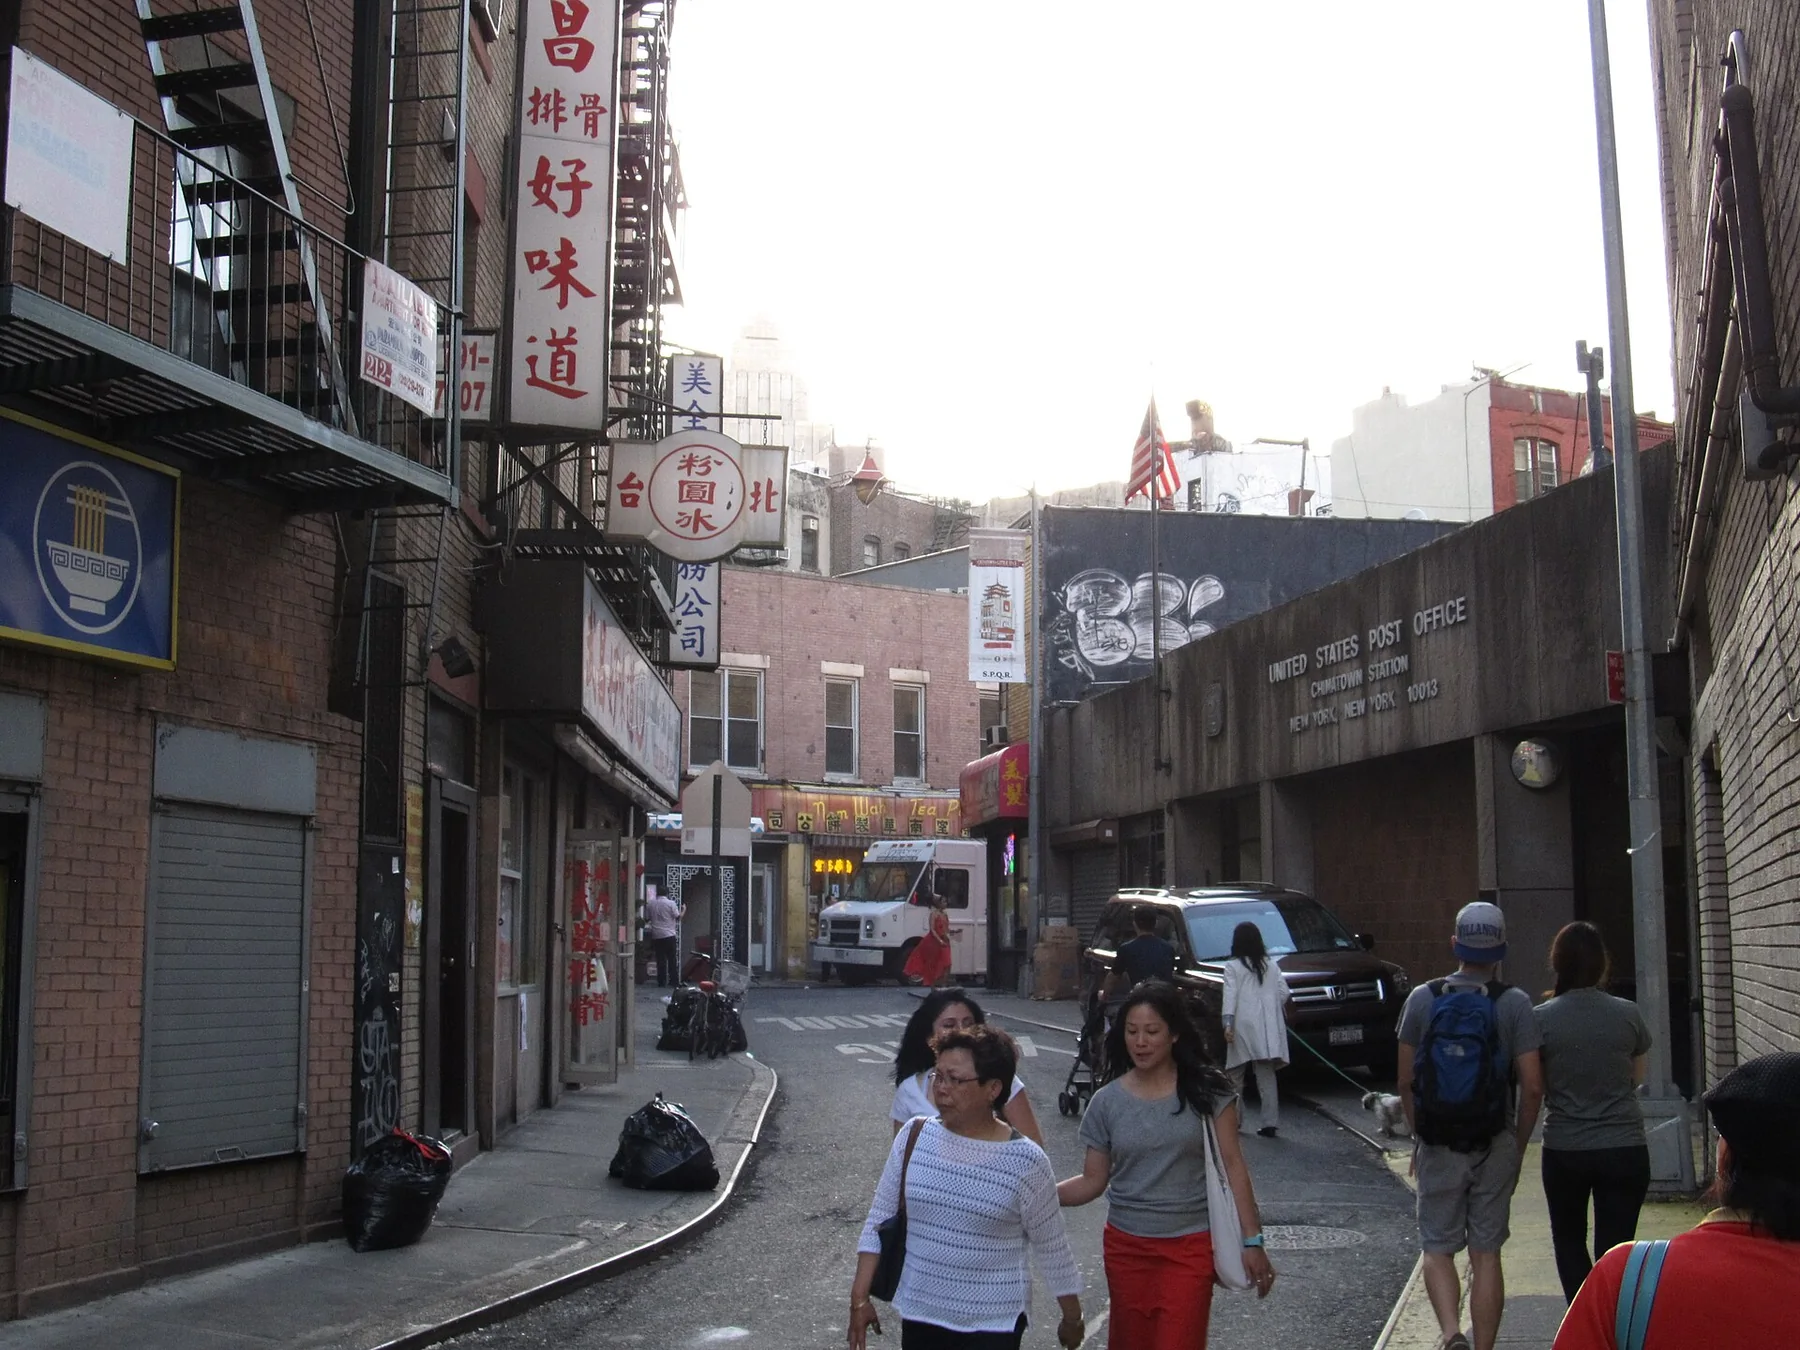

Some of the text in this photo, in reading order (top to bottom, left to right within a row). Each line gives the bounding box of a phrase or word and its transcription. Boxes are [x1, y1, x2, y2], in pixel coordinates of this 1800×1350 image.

[526, 86, 608, 139] 排骨
[523, 155, 597, 400] 好味道
[1269, 596, 1467, 684] UNITED STATES POST OFFICE
[1311, 654, 1409, 698] CHINATOWN STATION
[1290, 715, 1309, 734] NEW
[1343, 698, 1365, 720] NEW
[1370, 690, 1396, 712] YORK
[1407, 678, 1438, 703] 10013
